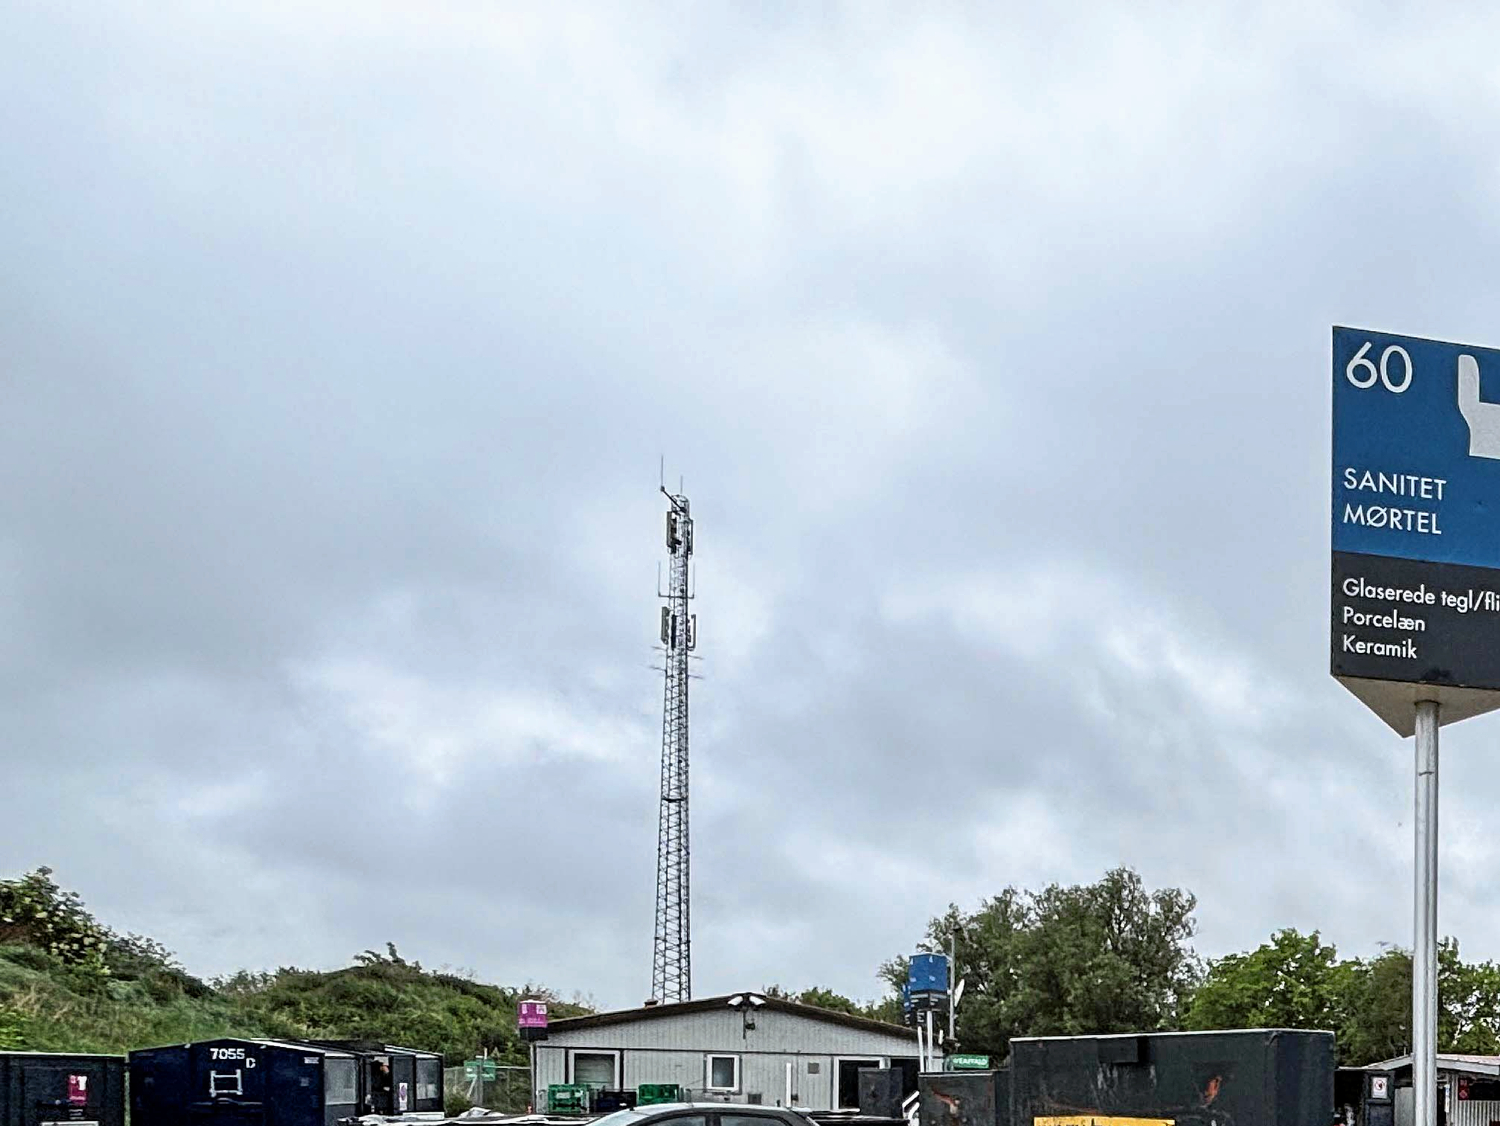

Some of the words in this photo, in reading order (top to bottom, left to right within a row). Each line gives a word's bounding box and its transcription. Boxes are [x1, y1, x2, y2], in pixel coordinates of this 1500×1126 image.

[1346, 341, 1413, 393] 60
[1343, 467, 1447, 501] SANITET
[1343, 503, 1442, 535] MØRTEL
[1342, 577, 1436, 606] Glaserede
[1343, 605, 1426, 632] Porcelæn
[1343, 634, 1418, 660] Keramik
[209, 1047, 246, 1060] 7055
